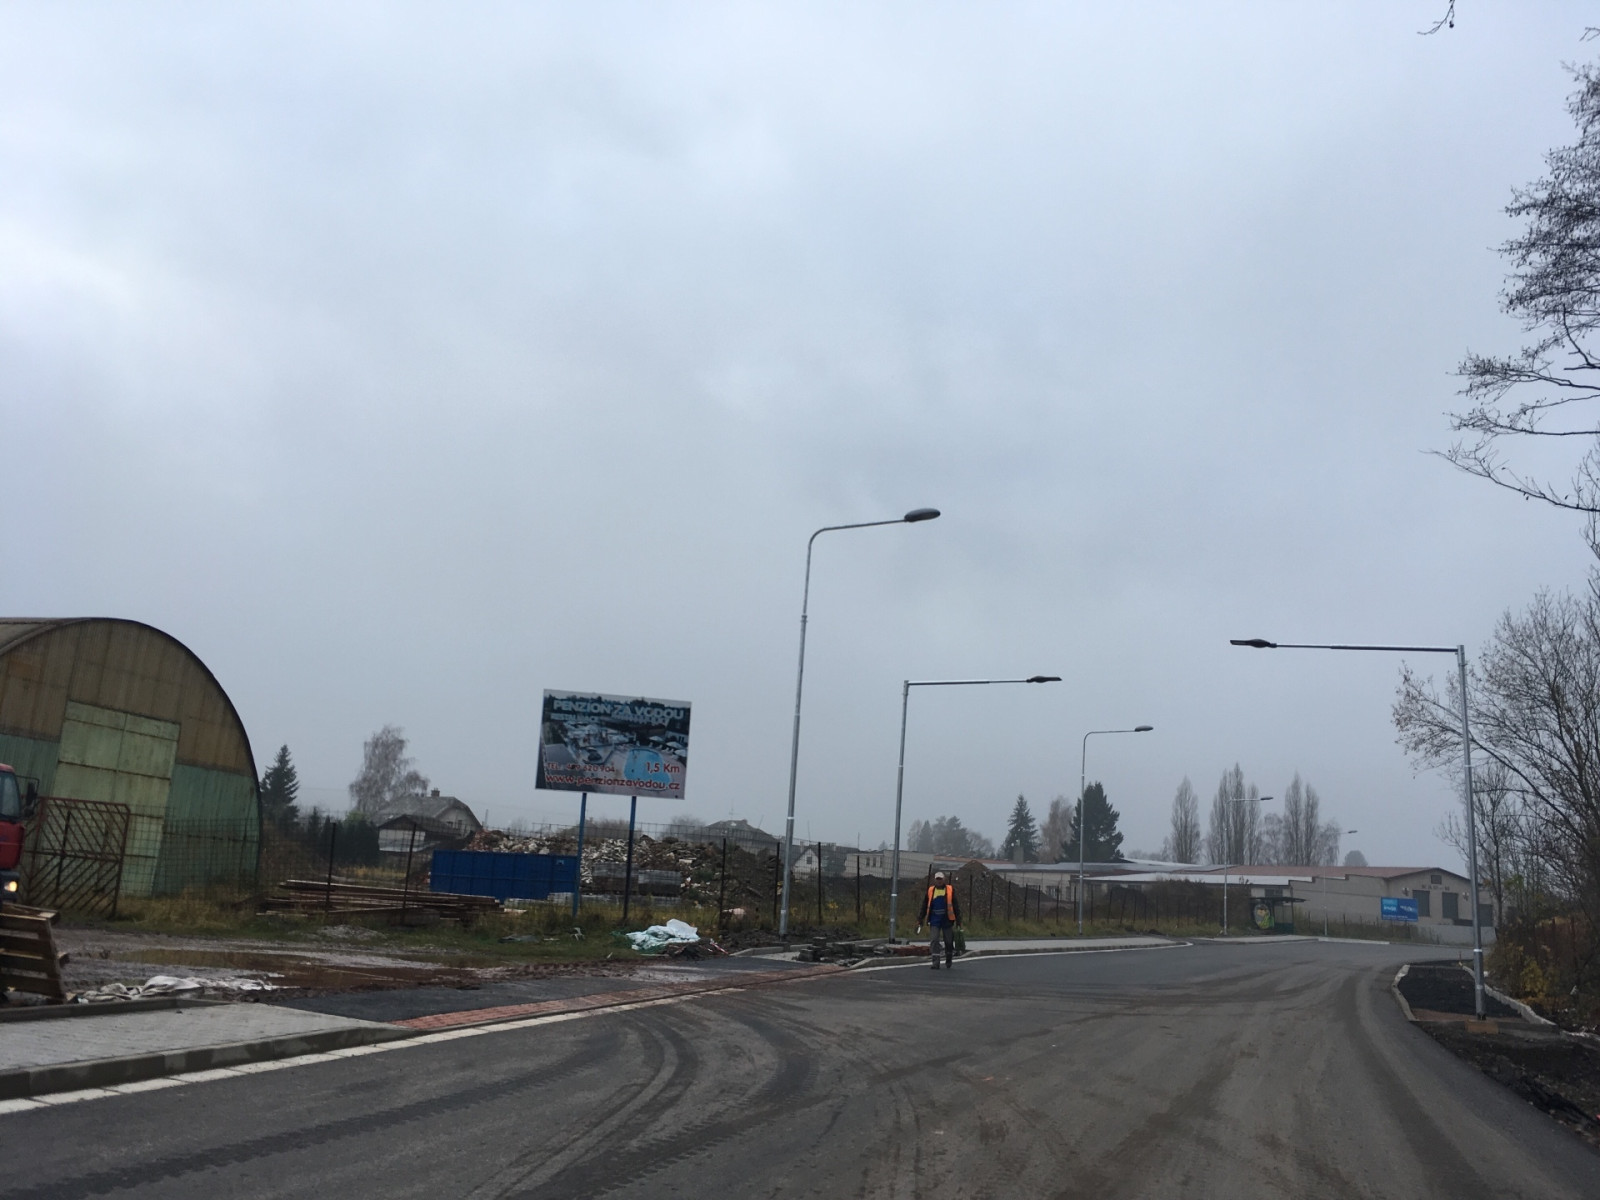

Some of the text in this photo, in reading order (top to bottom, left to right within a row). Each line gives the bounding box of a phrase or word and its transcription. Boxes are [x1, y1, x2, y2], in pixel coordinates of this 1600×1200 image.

[553, 699, 684, 719] PENZION ZA VODOU
[646, 762, 680, 773] 1,5 Km
[546, 775, 680, 790] www.penzionzavodou.cz
